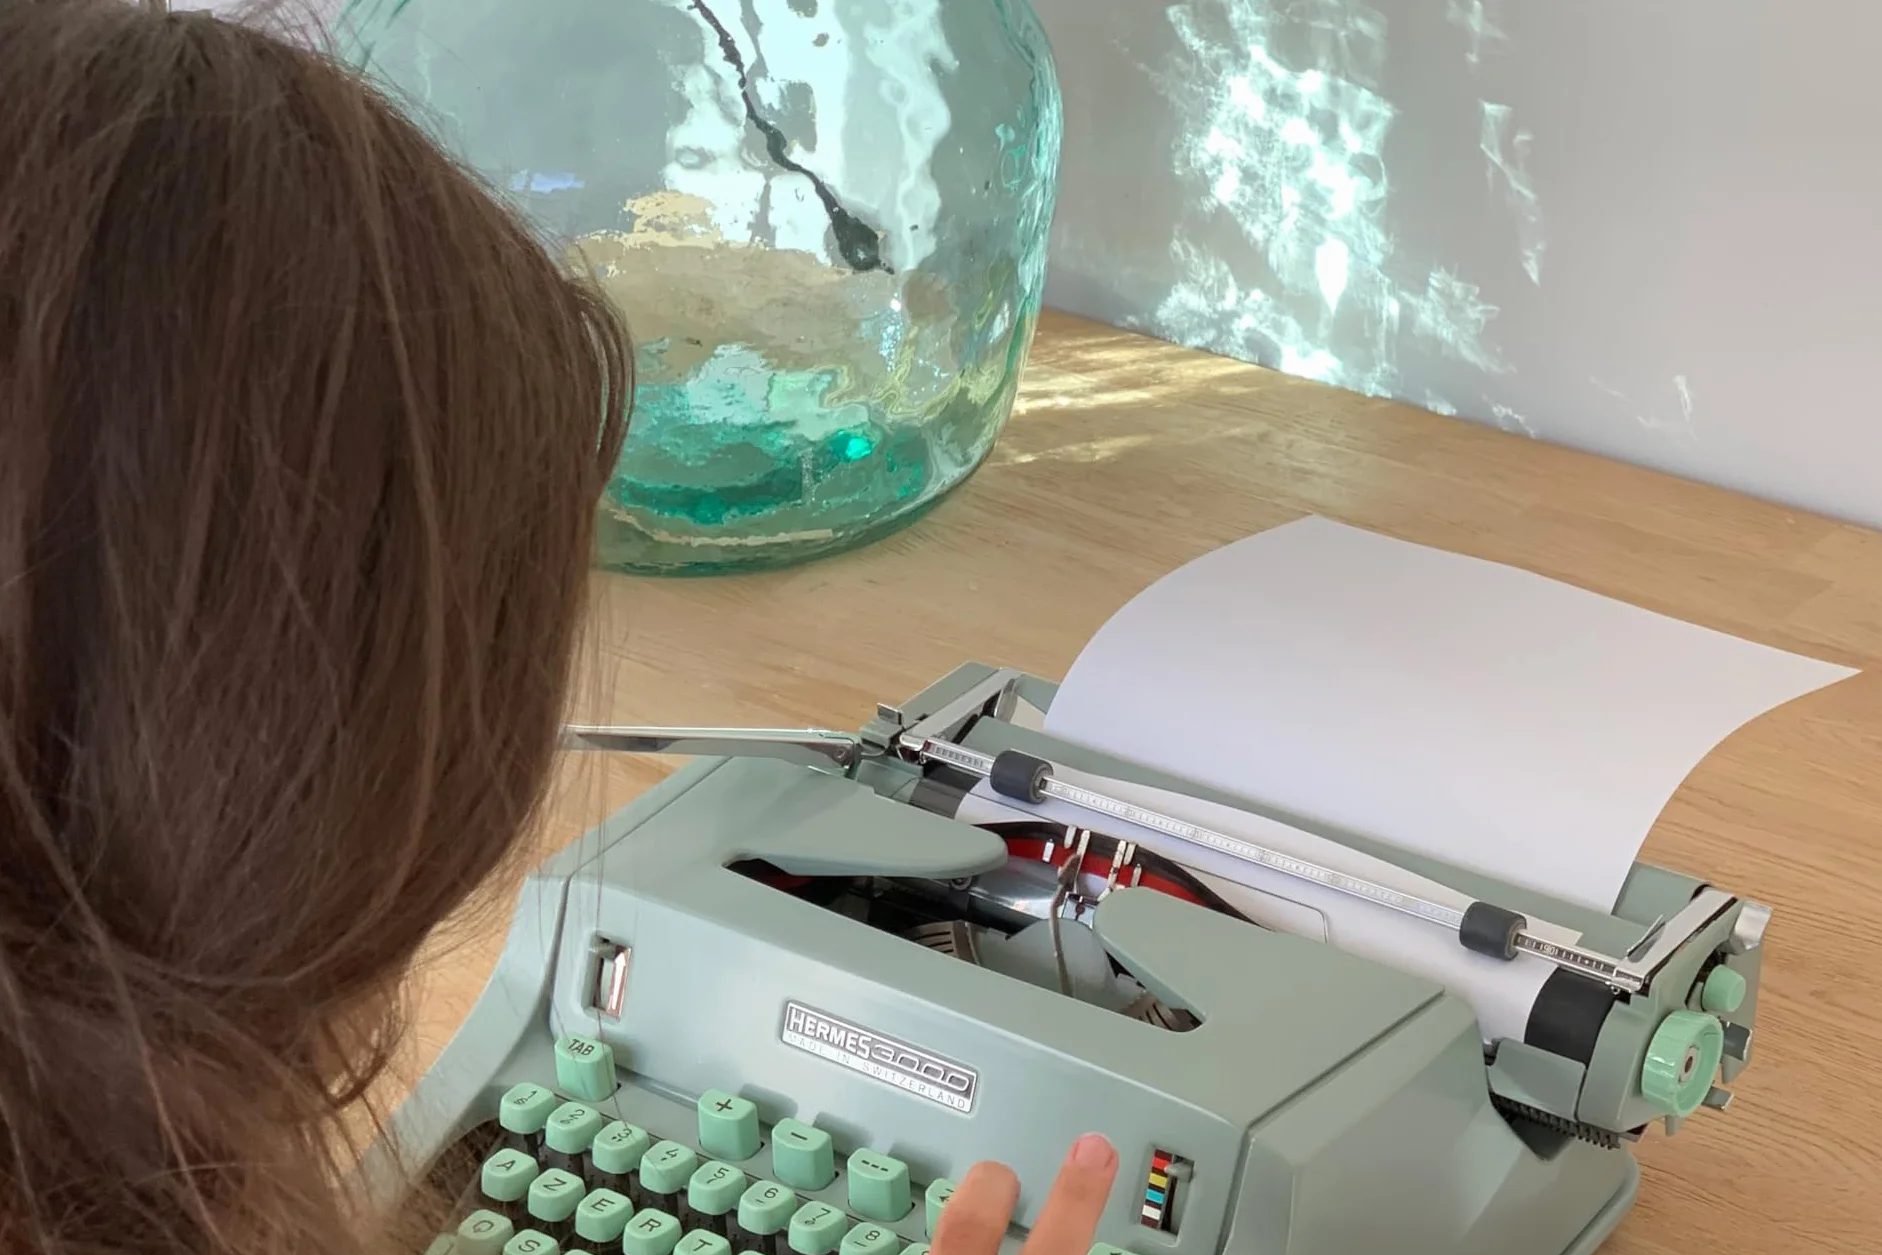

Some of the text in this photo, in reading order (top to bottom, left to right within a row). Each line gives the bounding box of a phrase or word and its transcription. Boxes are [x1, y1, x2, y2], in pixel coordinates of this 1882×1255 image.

[567, 1038, 596, 1056] TAB
[788, 1008, 970, 1092] HERMES 3000
[836, 1051, 851, 1065] IN
[862, 1062, 966, 1110] SWITZERLAND
[495, 1159, 517, 1172] A
[543, 1176, 568, 1192] Z
[591, 1197, 616, 1212] E
[638, 1217, 662, 1232] R
[692, 1238, 713, 1252] T
[472, 1219, 494, 1234] Q
[518, 1239, 541, 1253] S
